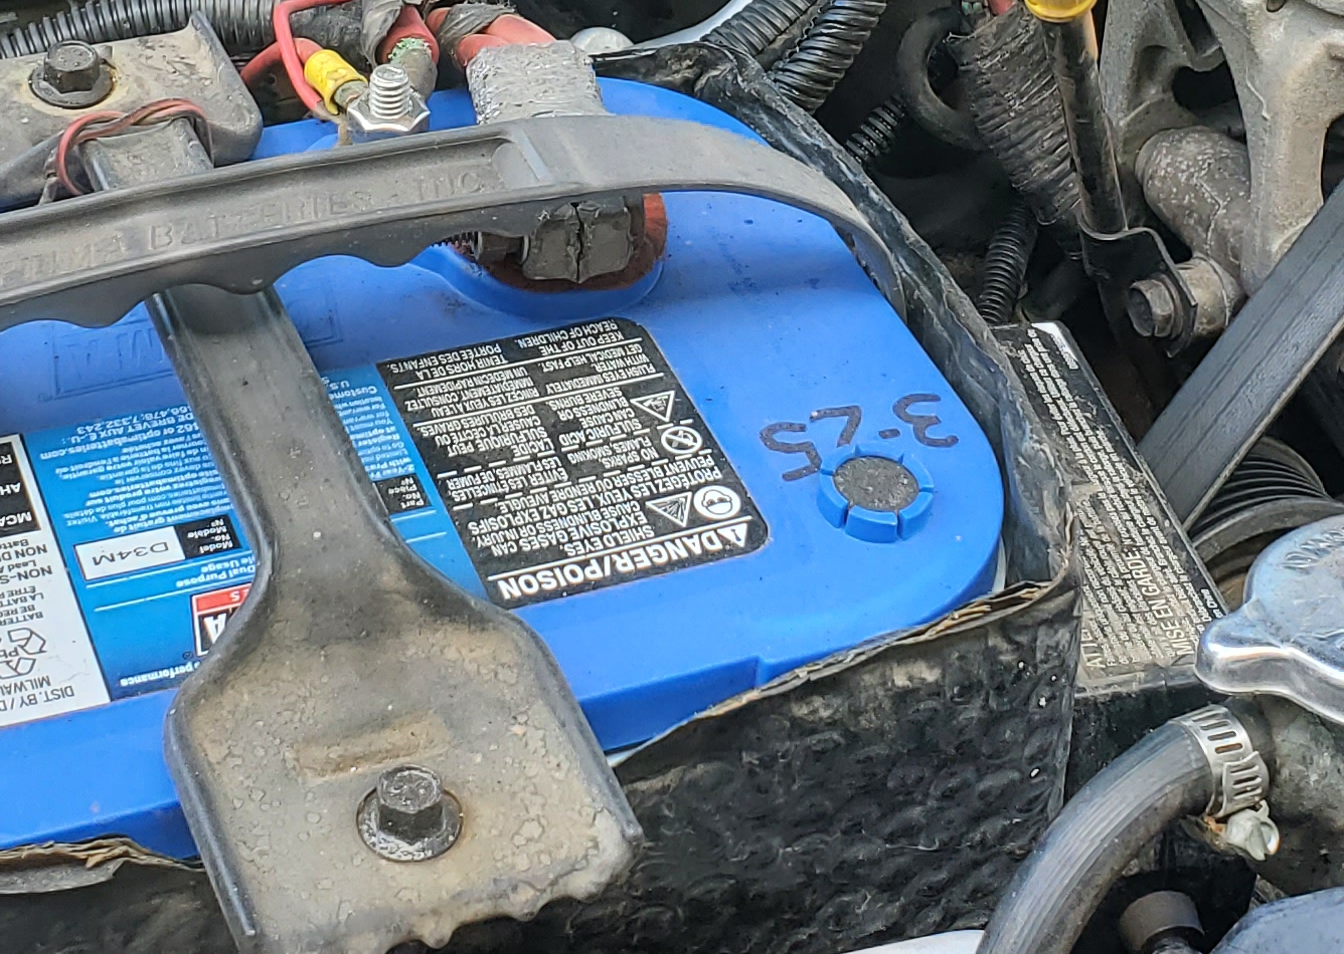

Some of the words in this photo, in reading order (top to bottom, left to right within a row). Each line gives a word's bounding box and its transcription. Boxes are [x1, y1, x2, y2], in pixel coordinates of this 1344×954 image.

[98, 426, 124, 438] AUX
[126, 418, 175, 433] BREVET
[655, 467, 722, 492] PROTÉGEZ
[591, 488, 633, 506] YEUX.
[630, 481, 657, 498] LES
[538, 502, 568, 519] GAZ
[566, 496, 594, 513] LES
[600, 500, 641, 519] CAUSE
[468, 508, 540, 534] EXPLOSIFS
[536, 509, 602, 533] BLINDNESS
[568, 511, 647, 540] EXPLOSIVE
[472, 527, 519, 547] INJURY.
[517, 528, 568, 551] GASES
[518, 523, 537, 538] OR
[603, 525, 655, 547] SHIELD
[14, 544, 48, 559] NON
[92, 541, 169, 566] D34M
[488, 538, 518, 556] CAN
[559, 537, 604, 556] EYES.
[7, 559, 37, 573] Lead
[497, 532, 721, 597] DANGER/POISON
[176, 571, 227, 588] Purpose
[28, 592, 45, 601] LA
[20, 604, 36, 614] BE
[120, 664, 193, 687] performance
[19, 693, 38, 708] BY
[39, 685, 75, 703] DIST.
